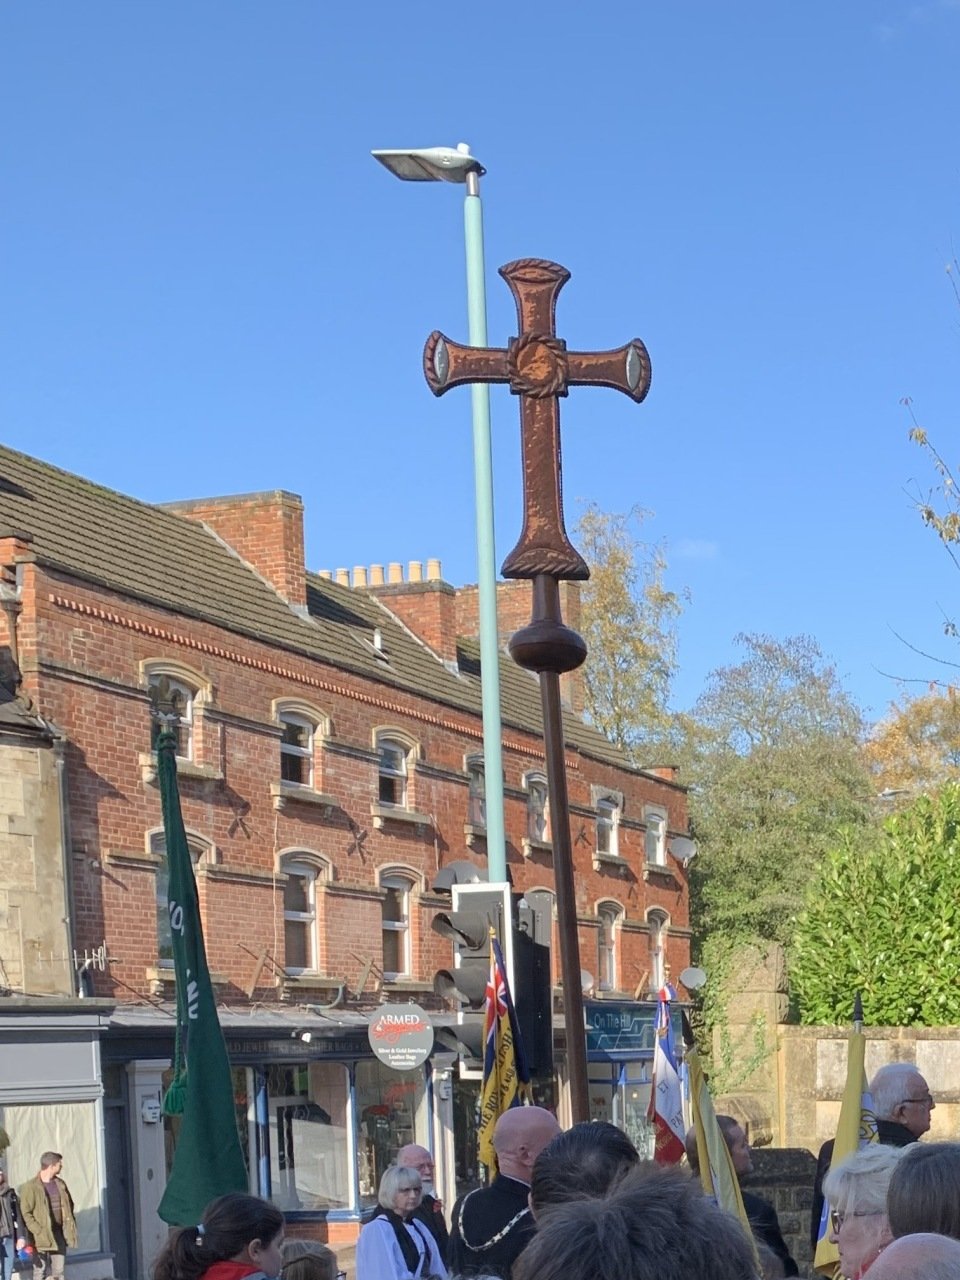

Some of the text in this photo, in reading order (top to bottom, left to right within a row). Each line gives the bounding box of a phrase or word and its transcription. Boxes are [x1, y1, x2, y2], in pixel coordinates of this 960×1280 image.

[379, 1014, 420, 1025] ARMED
[594, 1013, 631, 1028] On The Hill
